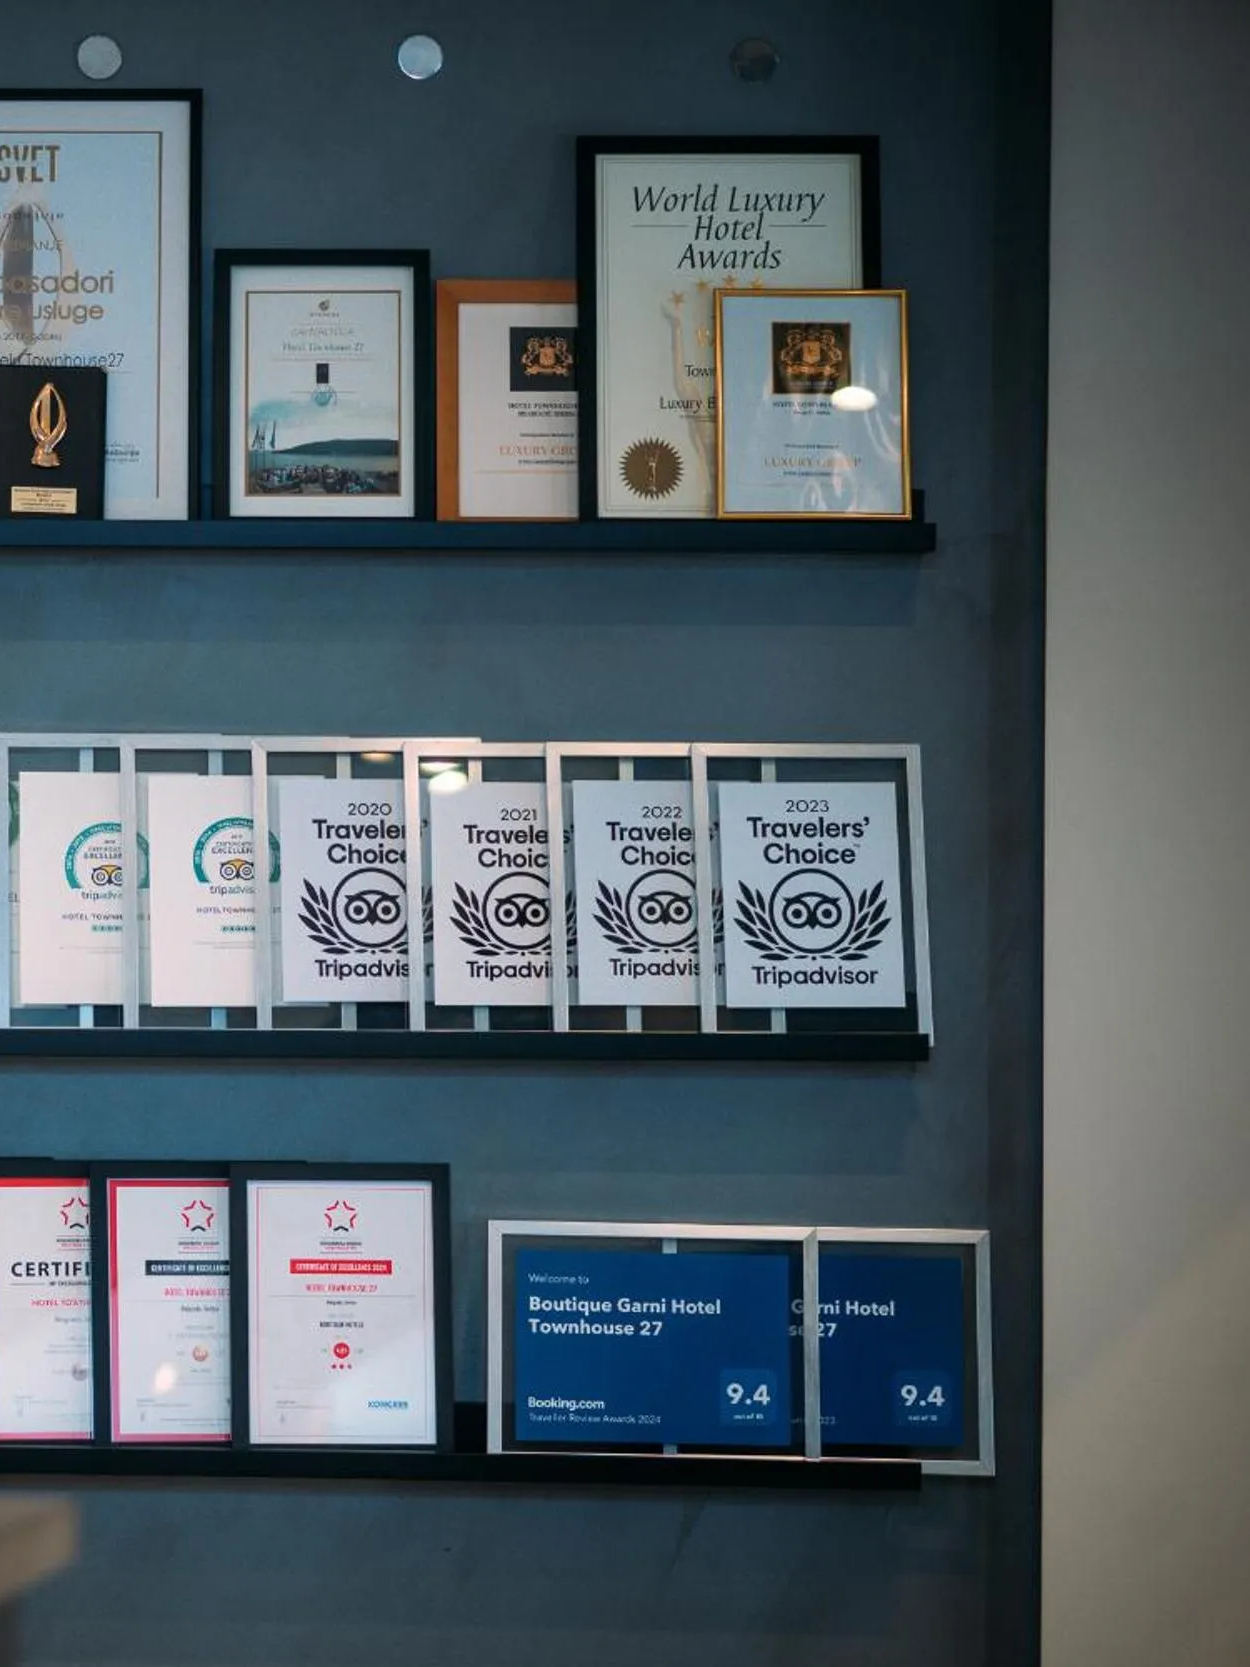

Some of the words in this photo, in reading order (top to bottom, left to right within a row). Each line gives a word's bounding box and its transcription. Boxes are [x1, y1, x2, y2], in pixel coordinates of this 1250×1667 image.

[633, 183, 720, 212] World
[728, 186, 827, 222] Luxury
[694, 212, 764, 240] Hotel
[677, 241, 782, 269] Awards
[659, 396, 703, 414] Luxury
[348, 803, 392, 816] 2020
[501, 808, 538, 821] 2021
[642, 806, 682, 819] 2022
[785, 799, 829, 813] 2023
[746, 816, 870, 838] Travelers'
[478, 848, 549, 868] Choic
[621, 845, 695, 865] Choic
[763, 842, 856, 864] Choice
[752, 966, 878, 988] Tripadvisor
[11, 1261, 90, 1278] CERTIFI
[528, 1273, 576, 1284] Welcome
[577, 1275, 589, 1285] to
[529, 1296, 612, 1316] Boutique
[617, 1298, 667, 1313] Garni
[671, 1299, 721, 1315] Hotel
[791, 1299, 841, 1315] Grni
[845, 1300, 895, 1316] Hotel
[528, 1318, 635, 1336] Townhouse
[639, 1321, 663, 1336] 27
[528, 1396, 605, 1411] Booking.com
[726, 1383, 771, 1406] 9.4
[901, 1384, 946, 1407] 9.4
[602, 1414, 636, 1424] Awards
